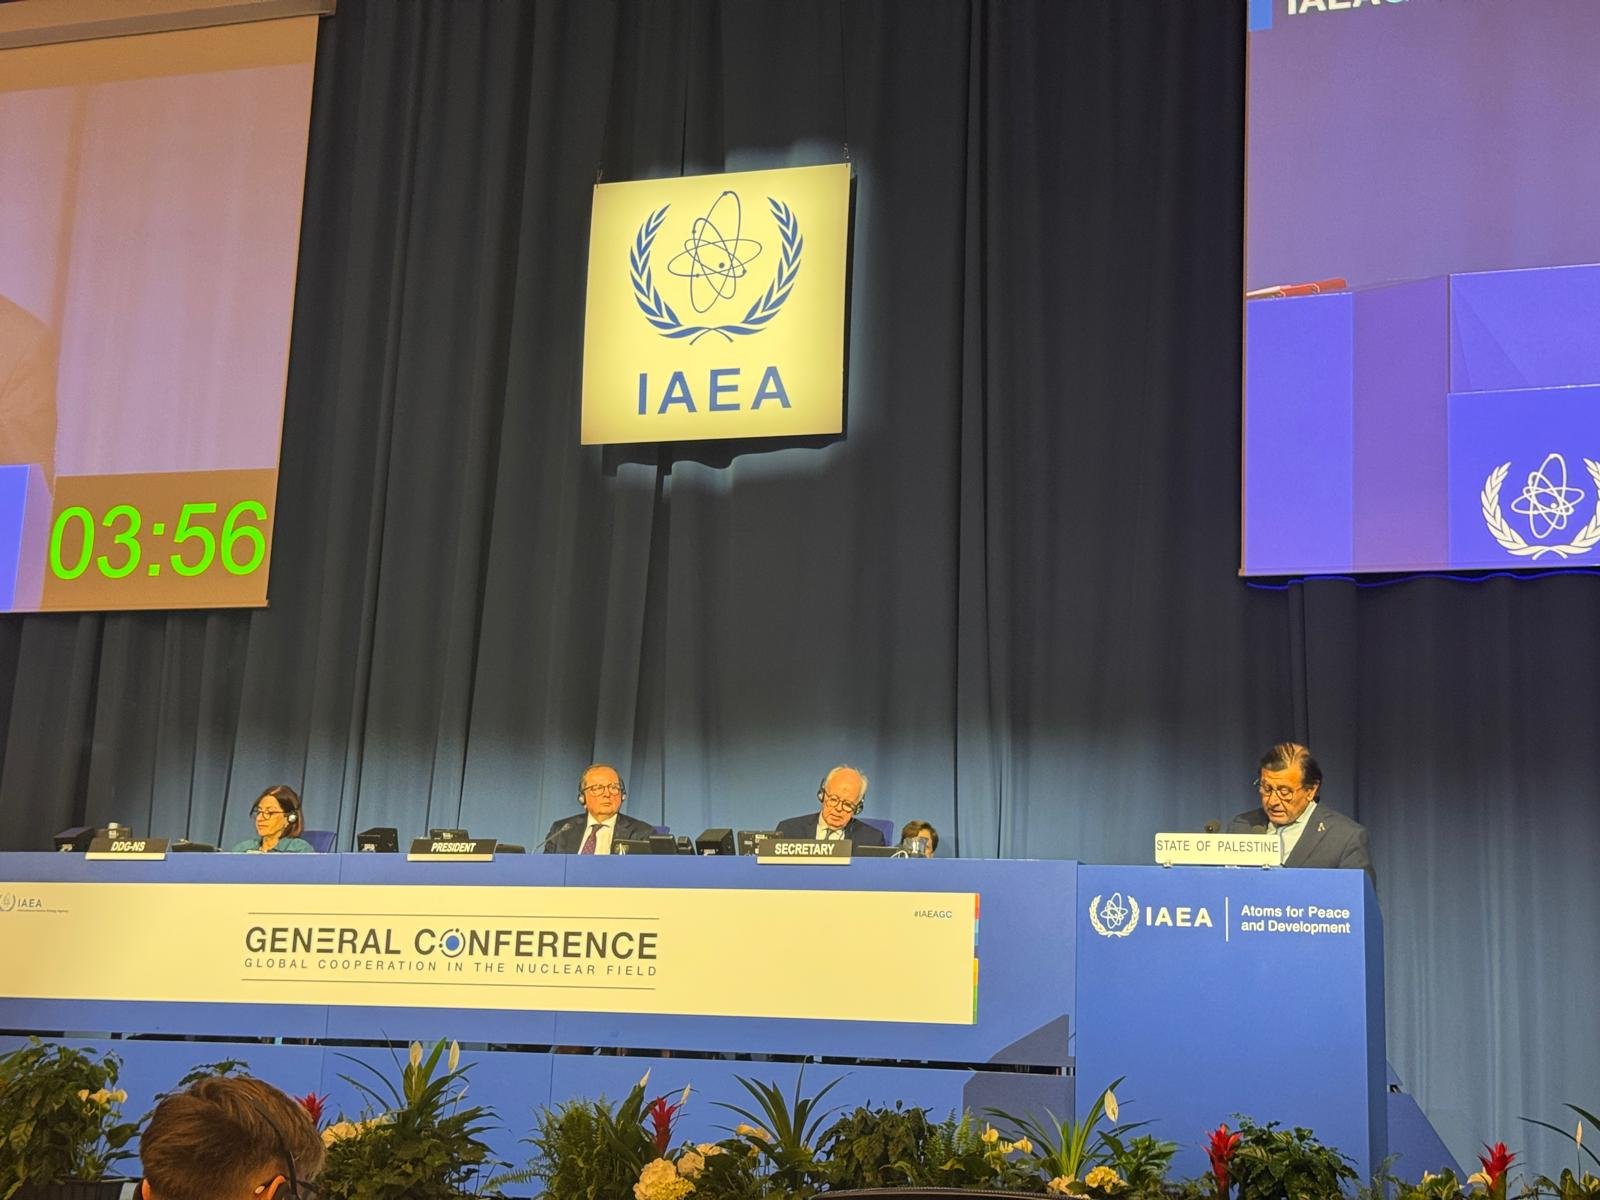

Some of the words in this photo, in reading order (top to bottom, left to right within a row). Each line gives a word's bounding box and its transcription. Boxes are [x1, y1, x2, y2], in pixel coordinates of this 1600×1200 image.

[638, 366, 791, 415] IAEA
[50, 500, 268, 580] 03:56
[111, 841, 146, 851] DDG-NS
[431, 842, 476, 853] PRESIDENT
[774, 843, 835, 855] SECRETARY
[1156, 840, 1190, 851] STATE
[1196, 840, 1211, 852] OF
[1217, 841, 1279, 853] PALESTINE
[17, 898, 42, 908] IAEA
[914, 910, 953, 919] #IAEAGC
[1146, 906, 1213, 928] IAEA
[1241, 905, 1282, 917] Atoms
[1286, 905, 1304, 918] for
[1308, 906, 1350, 919] Peace
[1241, 920, 1265, 932] and
[1268, 920, 1351, 935] Development
[245, 926, 402, 955] GENERAL
[414, 928, 658, 960] CONFERENCE
[244, 958, 308, 969] GLOBAL
[318, 959, 436, 972] COOPERATION
[447, 961, 463, 972] IN
[474, 962, 505, 973] THE
[516, 963, 595, 975] NUCLEAR
[606, 965, 657, 976] FIELD
